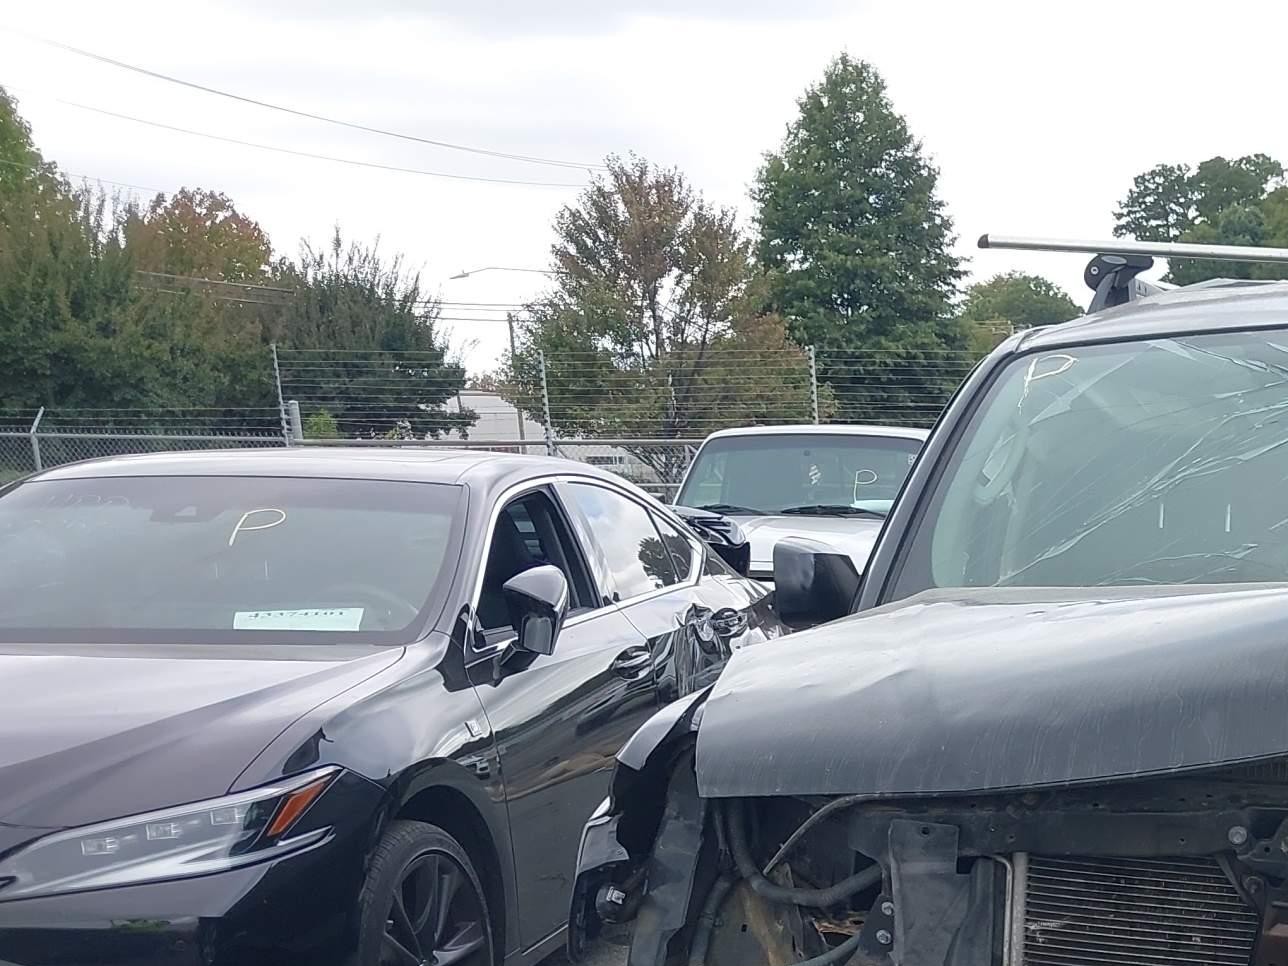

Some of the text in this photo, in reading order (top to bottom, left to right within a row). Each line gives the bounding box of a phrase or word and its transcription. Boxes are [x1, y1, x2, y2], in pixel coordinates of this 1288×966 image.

[1017, 354, 1080, 416] P
[853, 469, 878, 502] P
[228, 508, 287, 547] P
